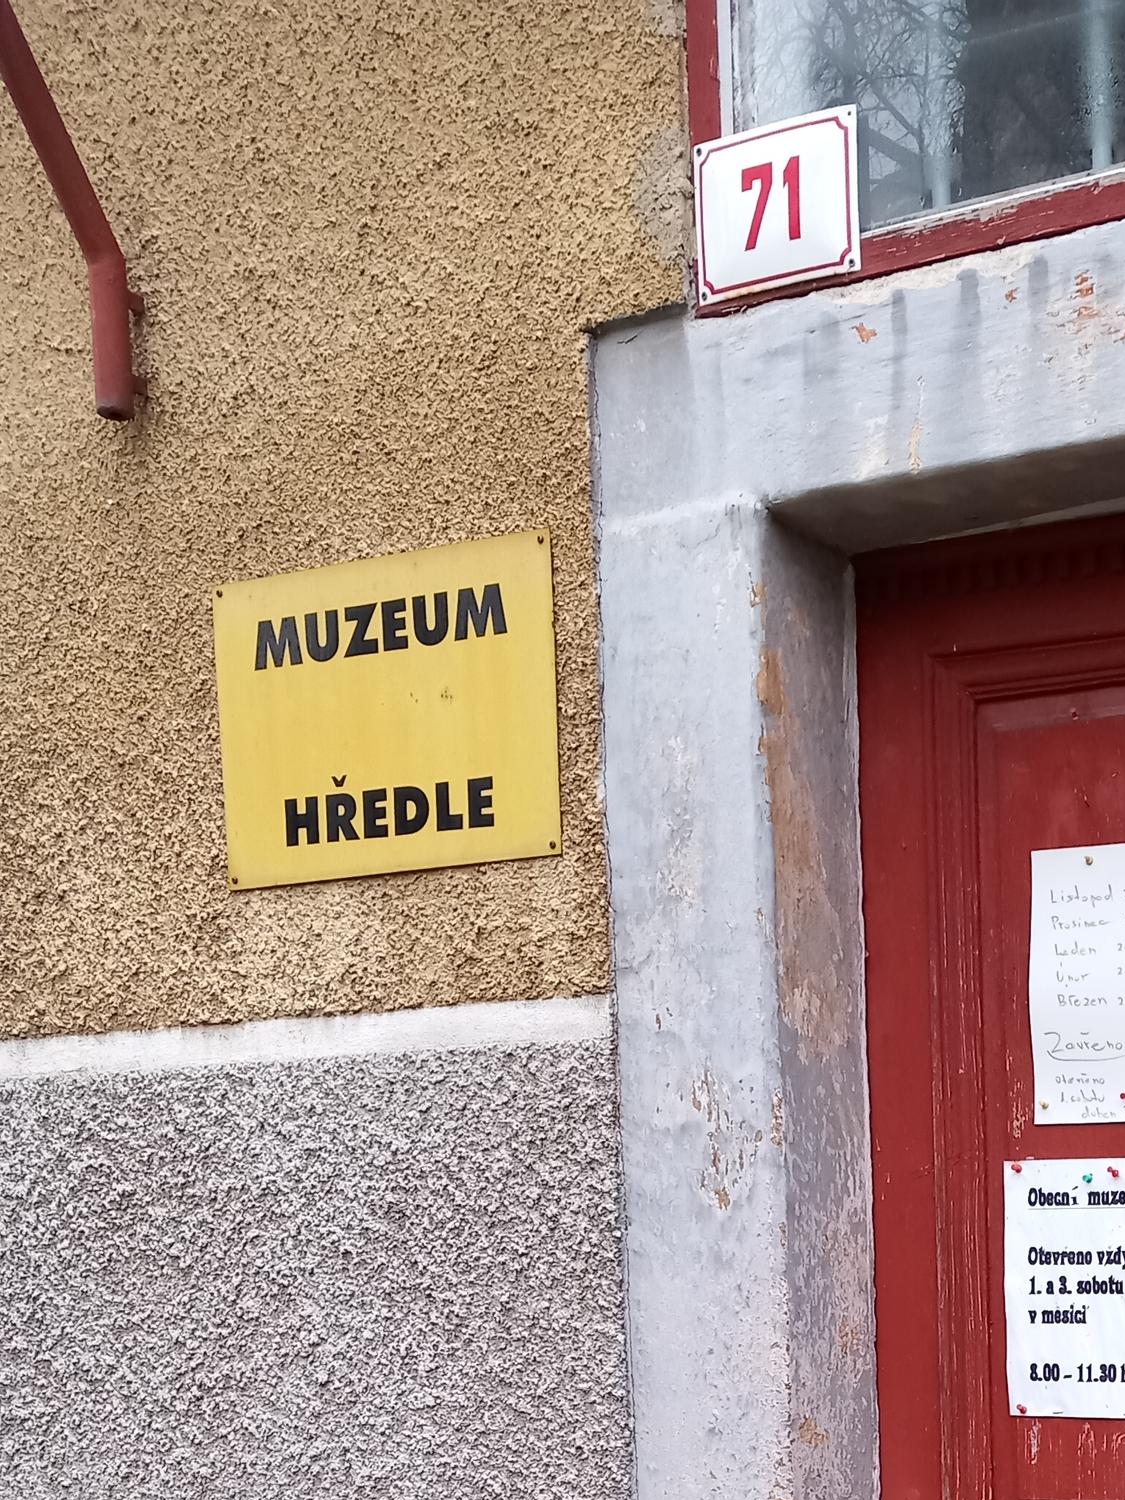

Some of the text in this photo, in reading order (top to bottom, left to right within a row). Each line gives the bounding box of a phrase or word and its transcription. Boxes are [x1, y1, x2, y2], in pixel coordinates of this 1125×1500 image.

[741, 154, 801, 252] 71
[254, 582, 508, 671] MUZEUM
[284, 774, 495, 847] HŘEDLE
[1050, 883, 1113, 908] Listopad
[1051, 915, 1111, 930] Prosinec
[1054, 940, 1097, 956] Leden
[1056, 961, 1090, 982] Únor
[1044, 1031, 1124, 1054] Zavřeno
[1027, 1185, 1079, 1207] Obecní
[1028, 1274, 1125, 1296] 1. a 3. sobotu
[1027, 1309, 1038, 1325] v
[1029, 1362, 1061, 1382] 8.00
[1076, 1362, 1118, 1383] 11.30
